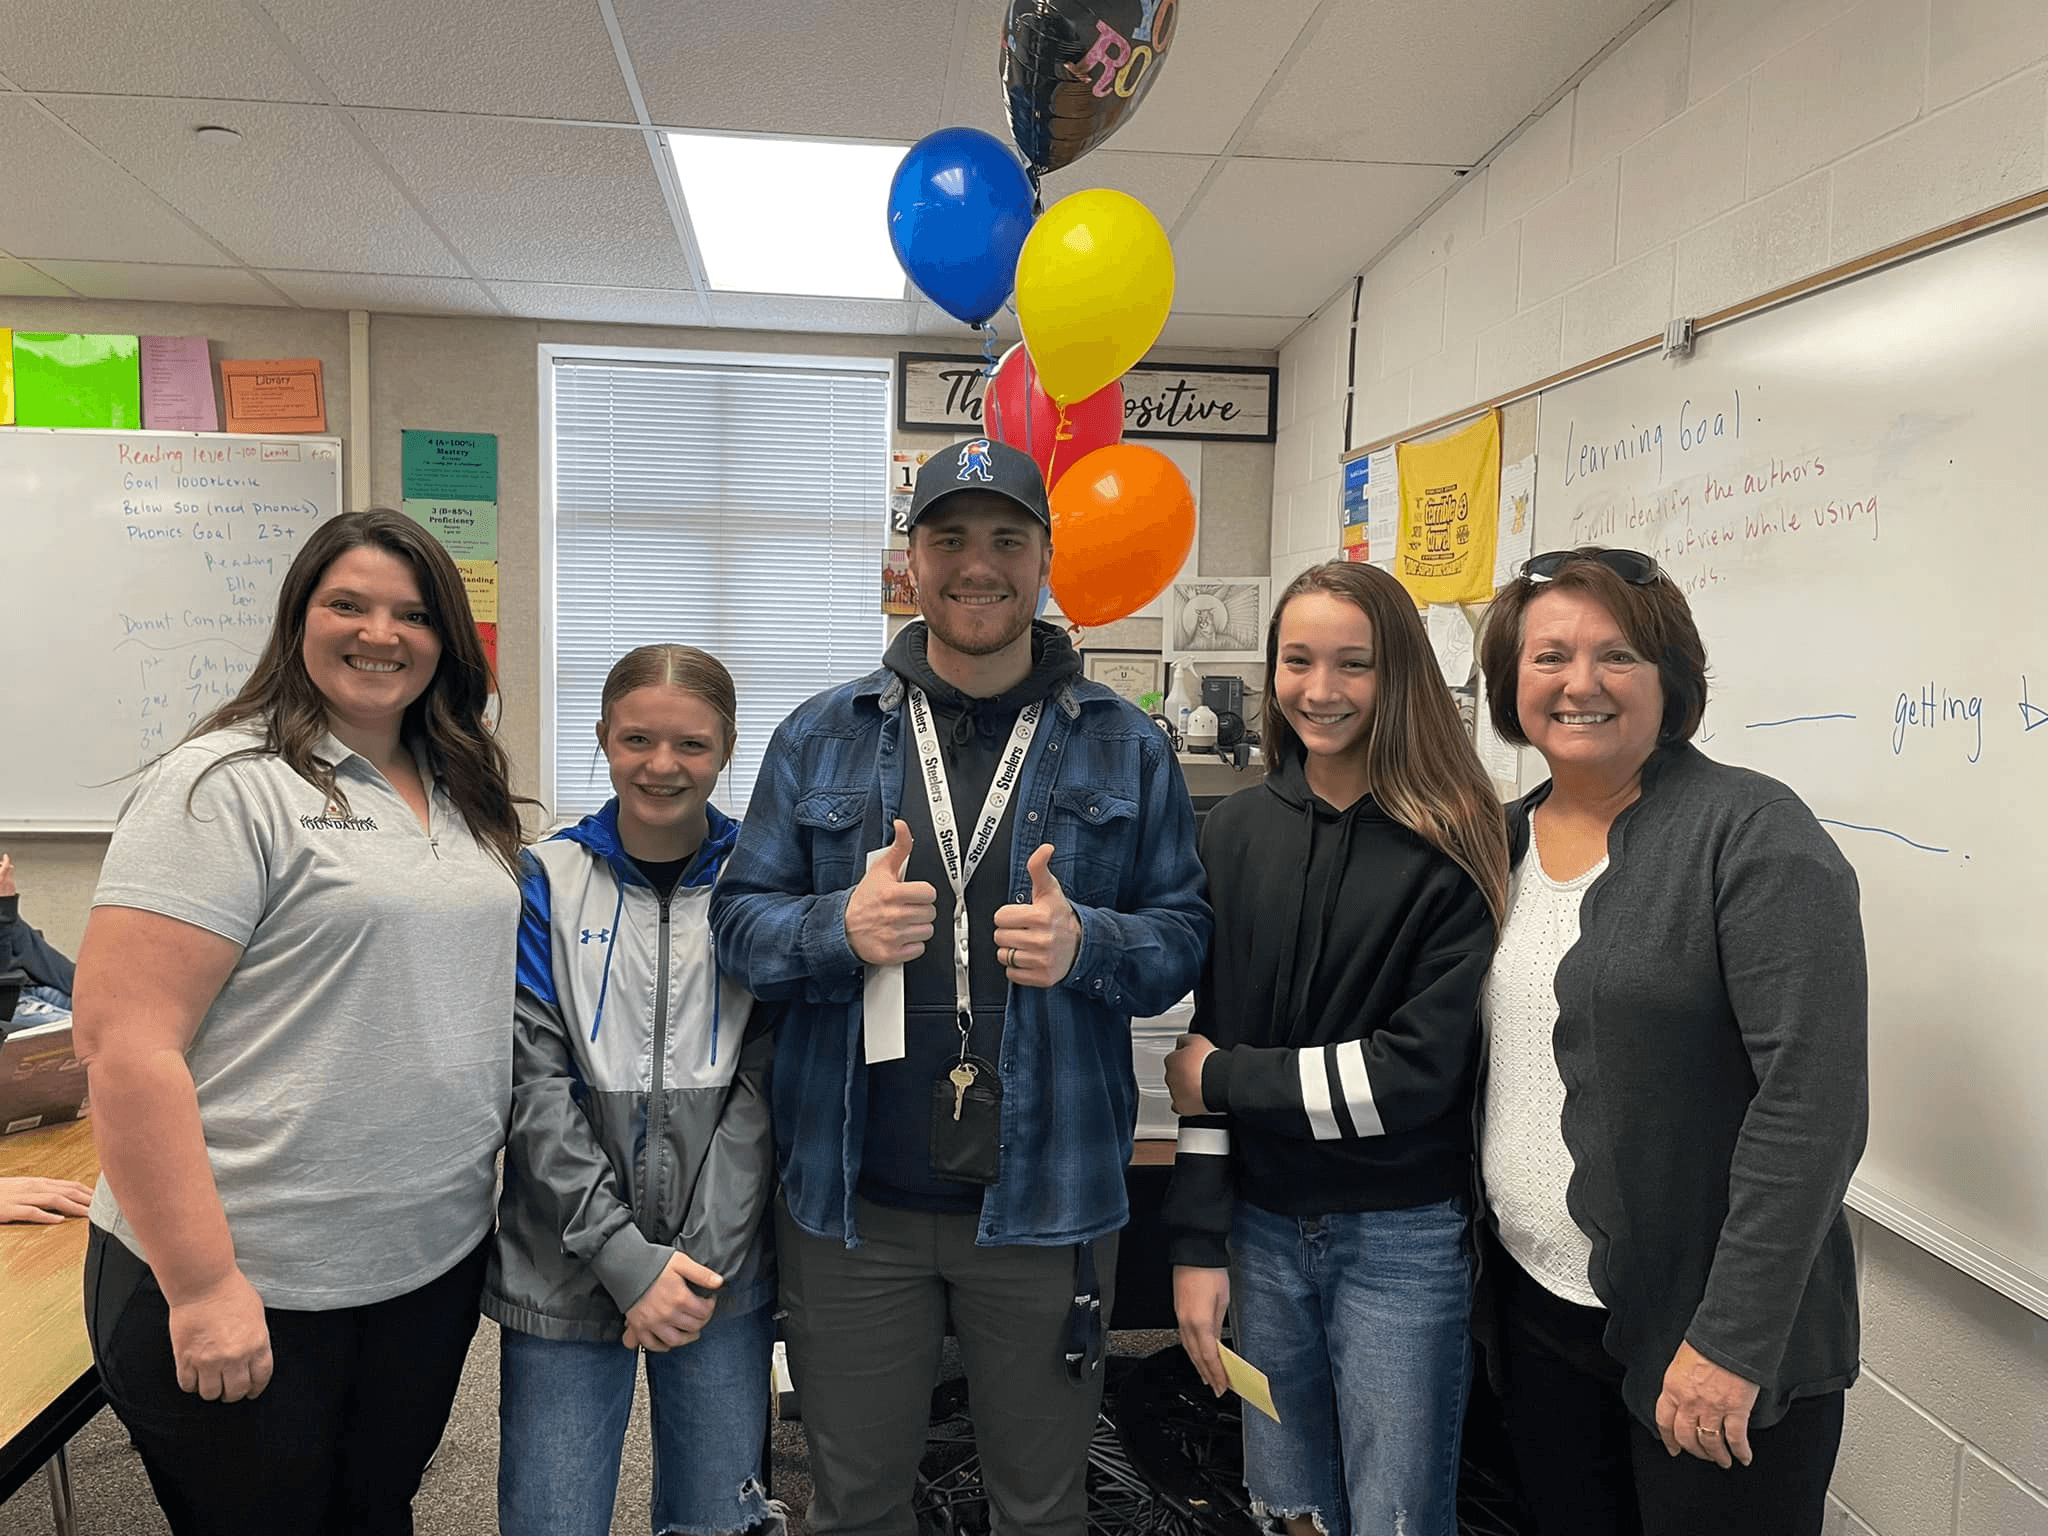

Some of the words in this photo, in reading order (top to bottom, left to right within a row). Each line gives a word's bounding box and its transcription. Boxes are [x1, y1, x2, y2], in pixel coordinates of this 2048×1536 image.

[939, 367, 984, 420] Th
[1120, 379, 1241, 428] ositive
[119, 443, 184, 474] Reading
[193, 446, 232, 464] level
[1563, 420, 1663, 486] Learning
[123, 471, 159, 491] Goal
[1704, 476, 1734, 505] the
[1743, 456, 1826, 495] authors
[123, 499, 162, 516] Below
[174, 501, 199, 514] 500
[429, 516, 476, 527] Proficiency
[126, 524, 183, 541] Phonics
[192, 521, 232, 541] Goal
[462, 576, 495, 585] tanding
[1681, 564, 1727, 594] ords.
[119, 610, 174, 636] Donut
[911, 689, 928, 734] Steelers
[1892, 680, 1983, 764] getting
[925, 756, 944, 804] Steelers
[995, 745, 1024, 792] Steelers
[939, 829, 958, 881] Steelers
[968, 814, 998, 866] Steelers
